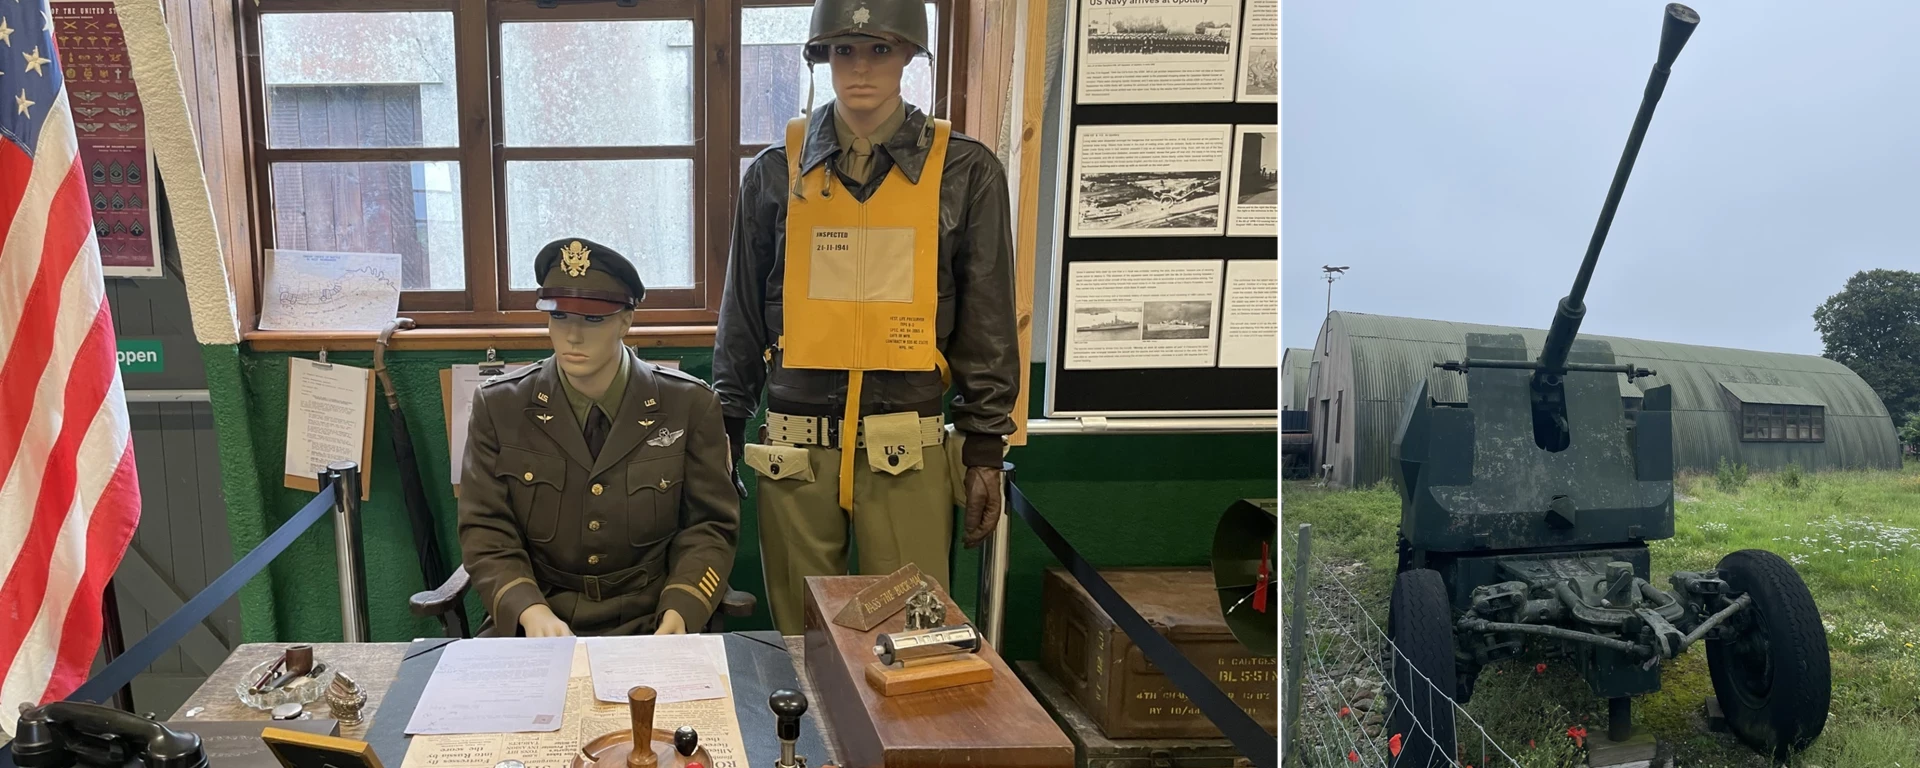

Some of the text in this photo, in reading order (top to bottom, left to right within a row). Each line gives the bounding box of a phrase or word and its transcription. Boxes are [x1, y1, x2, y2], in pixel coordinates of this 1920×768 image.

[117, 351, 157, 365] open
[884, 445, 909, 455] U.S.
[768, 454, 785, 463] U.S.
[1219, 670, 1238, 682] BL
